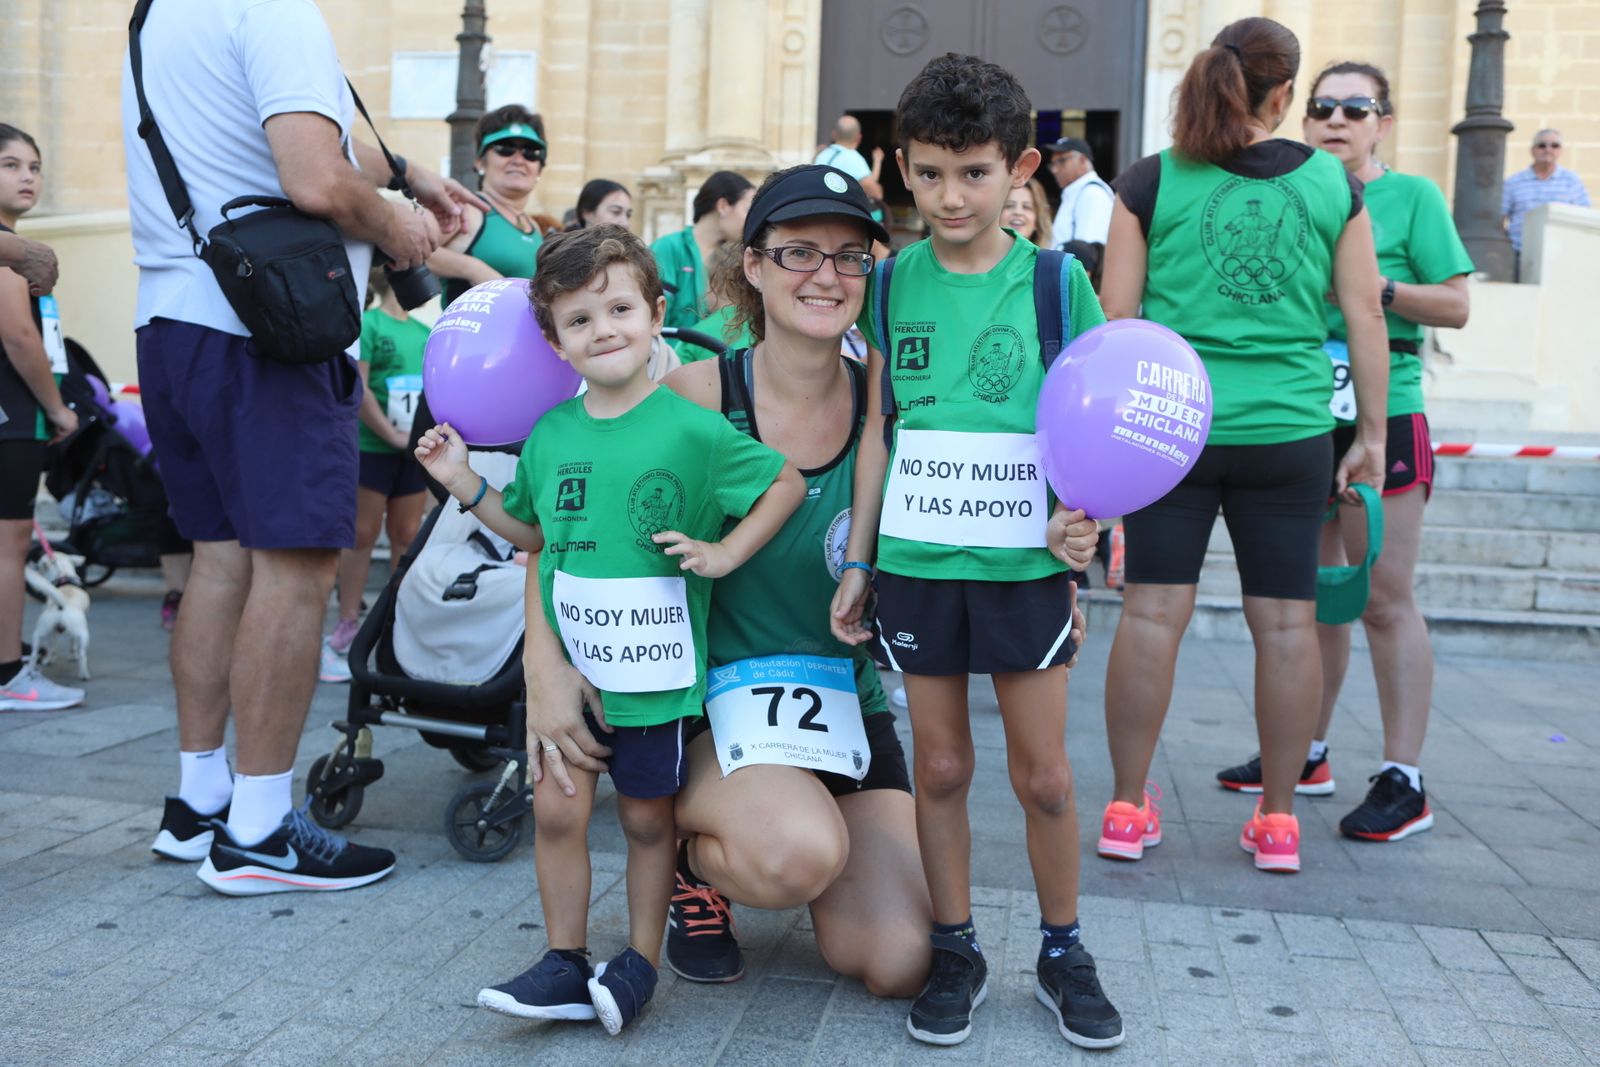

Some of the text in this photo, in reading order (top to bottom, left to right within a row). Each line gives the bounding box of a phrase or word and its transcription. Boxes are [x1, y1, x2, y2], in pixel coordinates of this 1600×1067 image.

[1205, 221, 1214, 246] CLUB
[1218, 284, 1286, 305] CHICLANA
[1136, 360, 1206, 405] CARRERA
[973, 390, 1010, 404] CHICLANA
[1166, 392, 1177, 401] DE
[1138, 394, 1200, 425] MUJER
[1122, 409, 1200, 444] CHICLANA
[1112, 425, 1190, 467] moneleg
[557, 466, 592, 477] HERCULES
[899, 458, 1038, 481] NO SOY MUJER
[904, 494, 1032, 518] Y LAS APOYO
[560, 601, 685, 627] NO SOY MUJER
[572, 637, 683, 663] Y LAS APOYO
[750, 659, 847, 674] Diputación DEPORTES
[753, 669, 795, 678] de Cádiz
[751, 686, 829, 733] 72
[758, 743, 800, 752] CARRERA
[811, 747, 822, 755] LA
[823, 749, 848, 760] MUJER
[784, 752, 823, 763] CHICLANA
